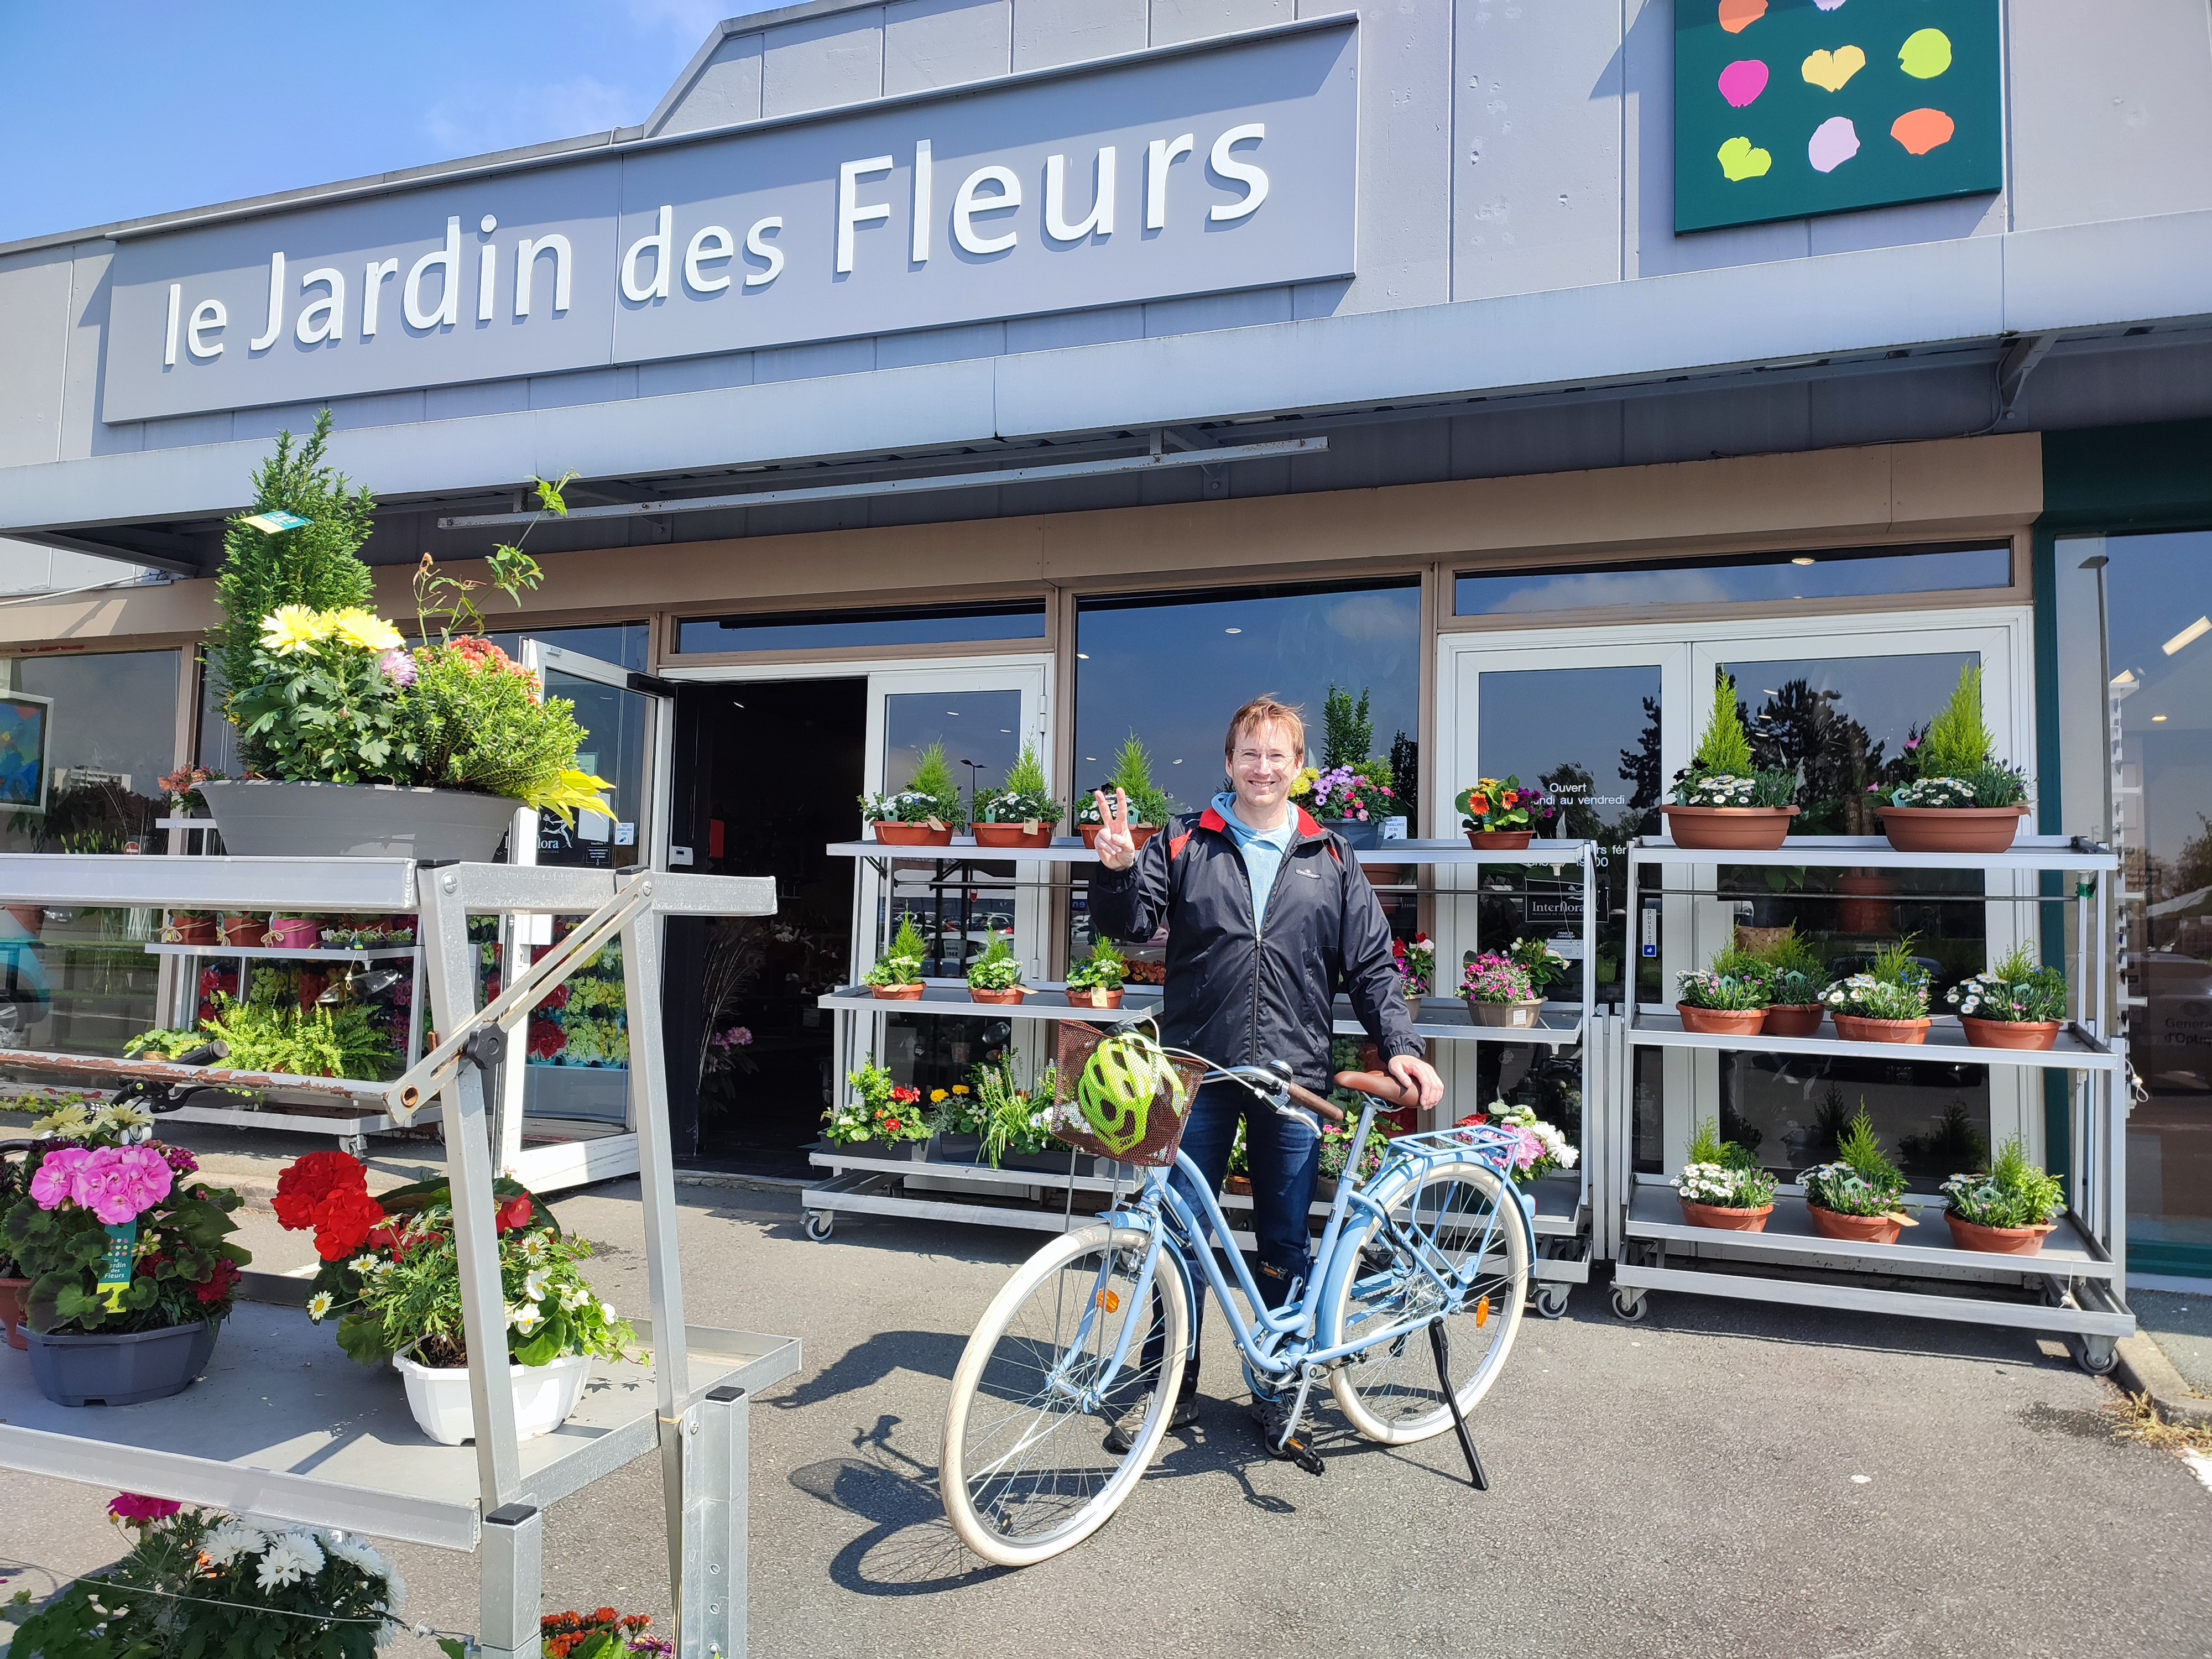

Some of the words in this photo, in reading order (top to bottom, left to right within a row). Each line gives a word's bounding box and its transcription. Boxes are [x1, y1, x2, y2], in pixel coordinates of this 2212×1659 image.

[165, 284, 227, 365] le
[251, 214, 572, 352] Jardin
[620, 205, 784, 301] des
[837, 123, 1270, 273] Fleurs
[1549, 782, 1587, 793] Ouvert
[1560, 797, 1573, 805] au
[1578, 795, 1625, 805] vendredi
[1532, 901, 1584, 912] Interflora
